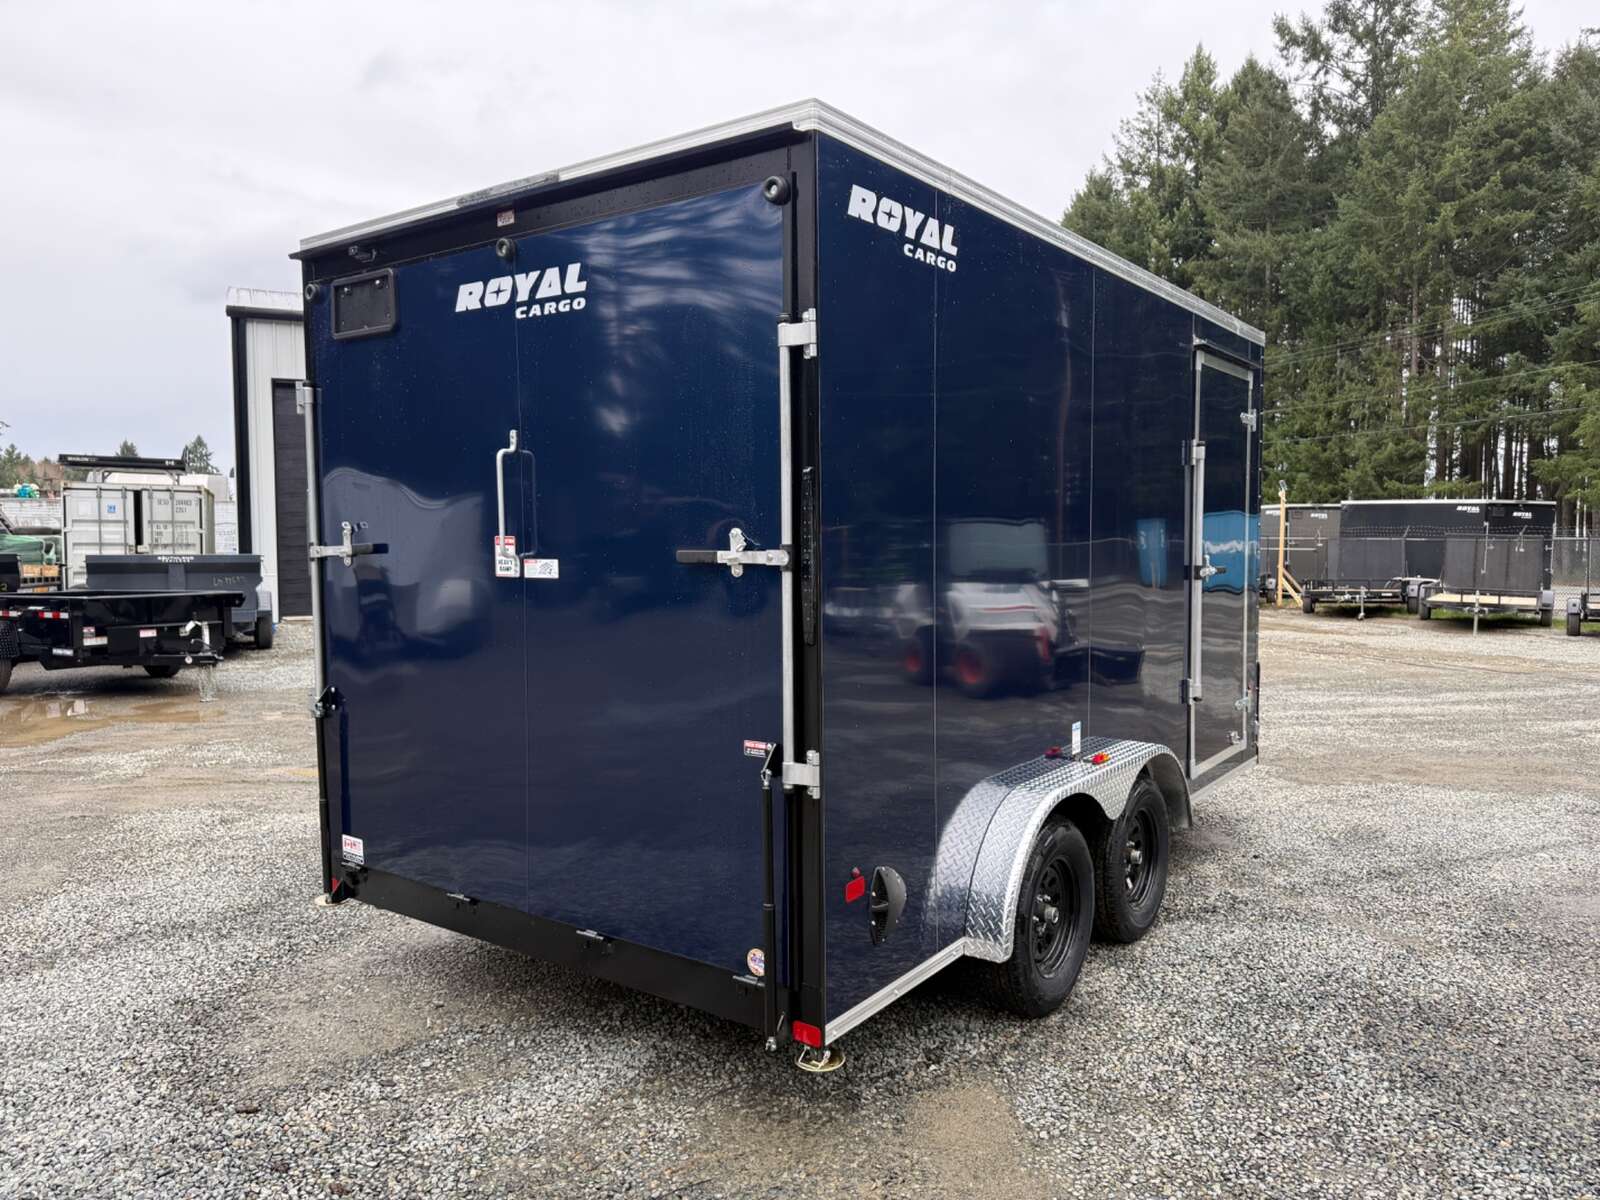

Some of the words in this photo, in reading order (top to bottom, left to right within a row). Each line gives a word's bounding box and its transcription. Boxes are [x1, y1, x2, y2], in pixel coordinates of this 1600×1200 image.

[847, 184, 958, 256] ROYAL
[903, 243, 957, 273] CARGO
[455, 262, 587, 313] ROYAL
[515, 297, 587, 319] CARGO
